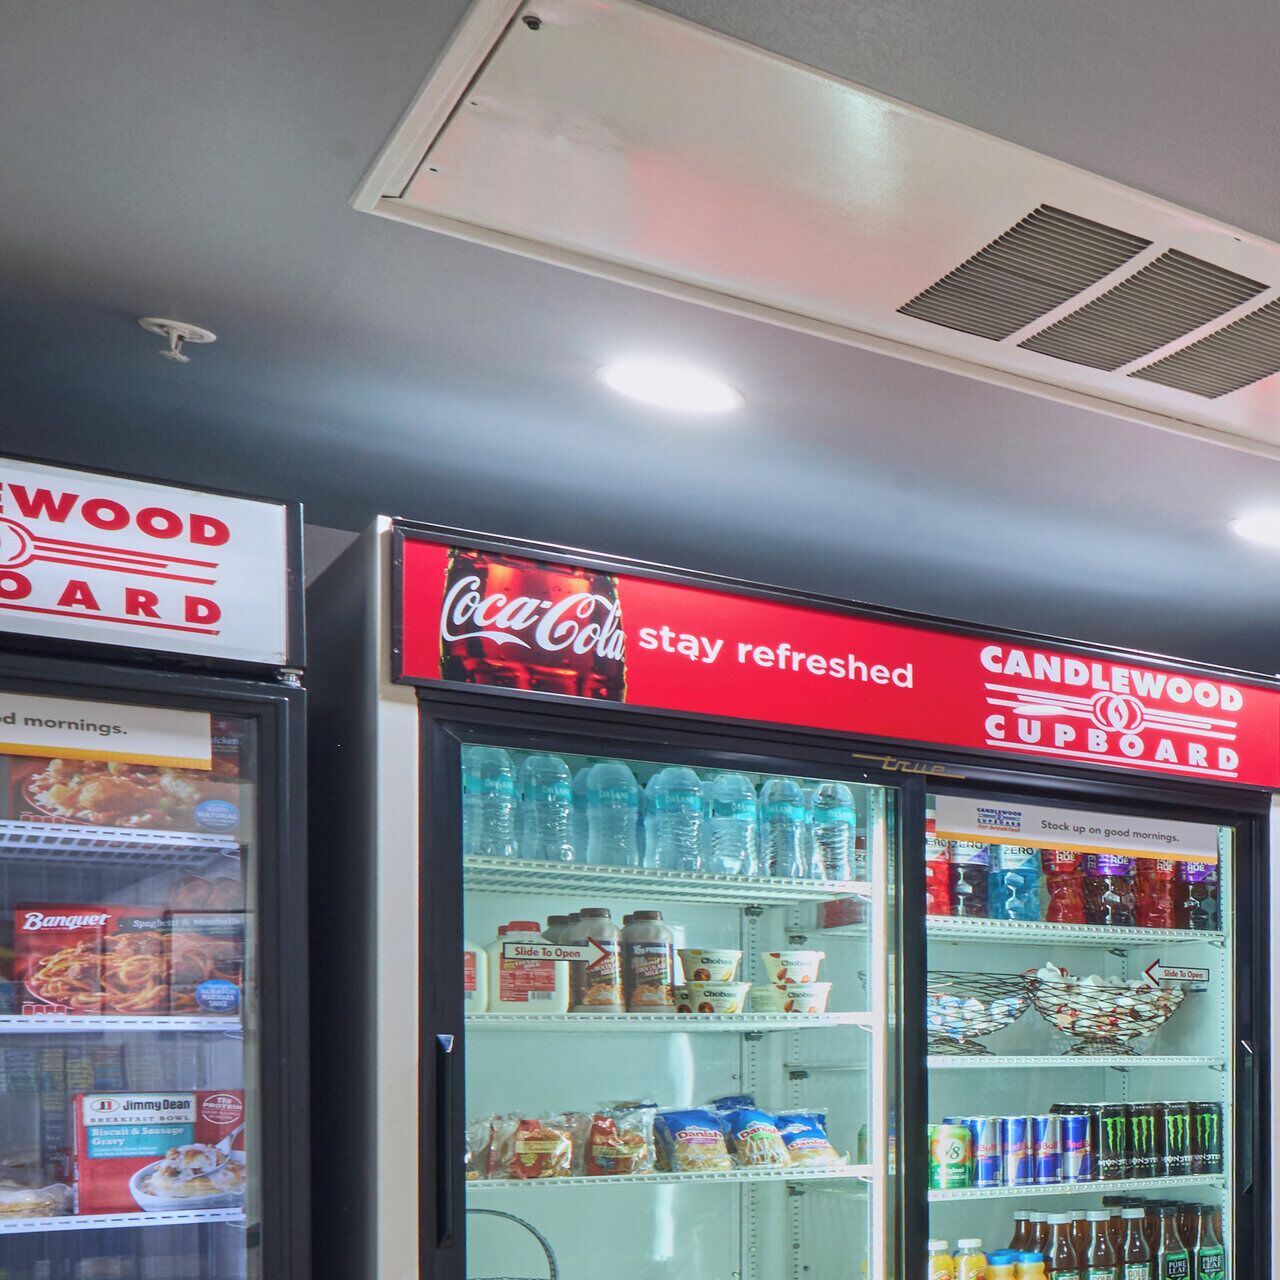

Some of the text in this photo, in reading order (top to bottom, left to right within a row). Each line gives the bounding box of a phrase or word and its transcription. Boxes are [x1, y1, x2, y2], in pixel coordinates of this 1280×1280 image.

[0, 482, 230, 547] WOOD
[440, 574, 626, 662] Coca-Cola
[638, 624, 914, 689] stay refreshed
[979, 645, 1243, 712] CANDLEWOOD
[24, 715, 128, 736] mornings.
[984, 714, 1240, 771] CUPBOARD
[976, 807, 1022, 817] CANDLEWOOD
[1041, 820, 1070, 831] Stock
[1073, 826, 1086, 835] up
[1104, 829, 1130, 838] good
[1132, 831, 1180, 843] mornings.
[22, 912, 111, 931] Banquet
[514, 946, 580, 959] Slide To Open
[1164, 969, 1178, 978] Slide
[123, 1098, 190, 1111] Jimmy Dean
[90, 1115, 154, 1123] BREAKFAST
[92, 1127, 129, 1137] Biscuit
[142, 1126, 184, 1137] Sausage
[677, 1130, 724, 1140] Danish
[92, 1137, 124, 1147] Gravy
